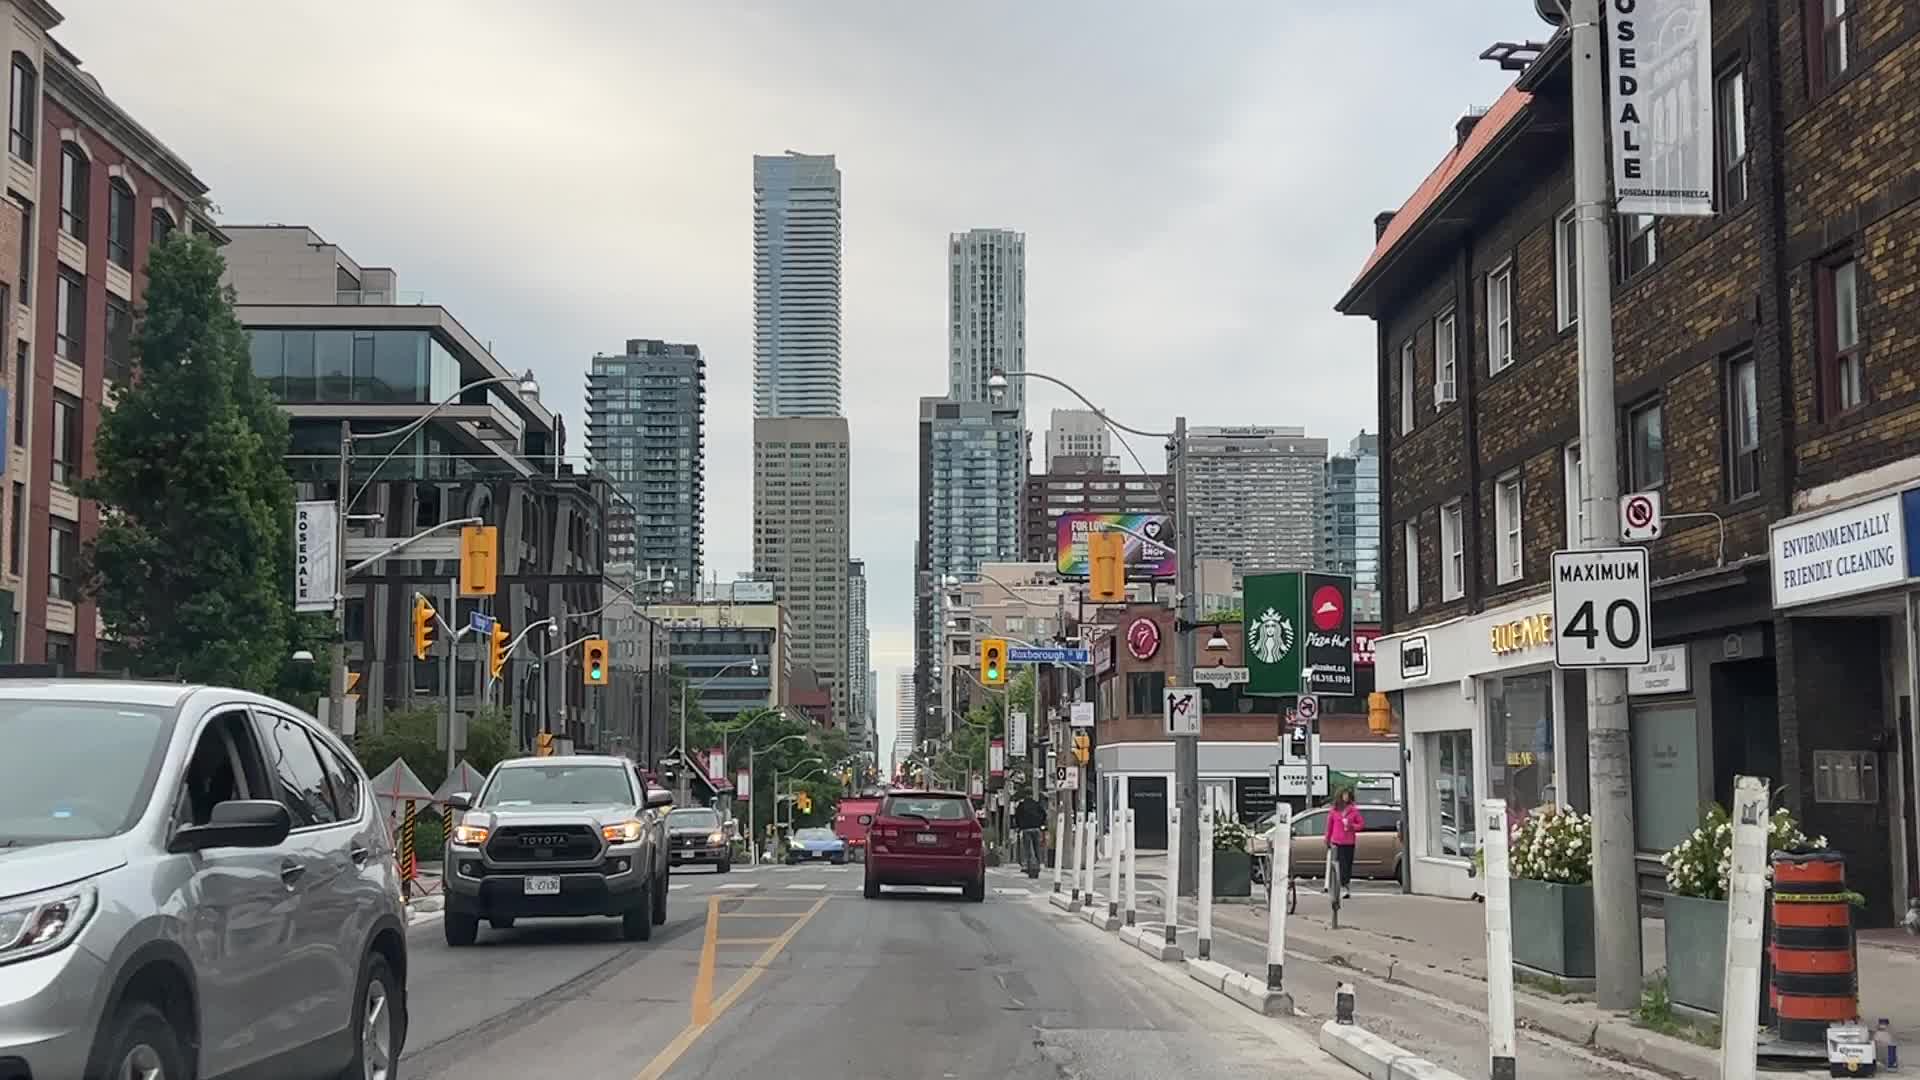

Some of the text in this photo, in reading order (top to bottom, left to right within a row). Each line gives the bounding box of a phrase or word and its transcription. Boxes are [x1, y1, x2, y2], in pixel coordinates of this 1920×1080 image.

[1071, 520, 1088, 531] FOR
[1783, 513, 1890, 559] ENVIRONMENTALLY
[298, 511, 308, 598] ROSEDALE
[1560, 562, 1639, 582] MAXIMUM
[1783, 545, 1895, 589] FRIENDLY CLEANING
[1562, 599, 1641, 649] 40
[1304, 632, 1351, 648] Pizza Hut
[1010, 650, 1065, 661] Roxborough
[1075, 650, 1084, 660] W
[1195, 671, 1233, 683] Roxborough
[1234, 671, 1240, 681] St
[522, 836, 566, 845] TOYOTA
